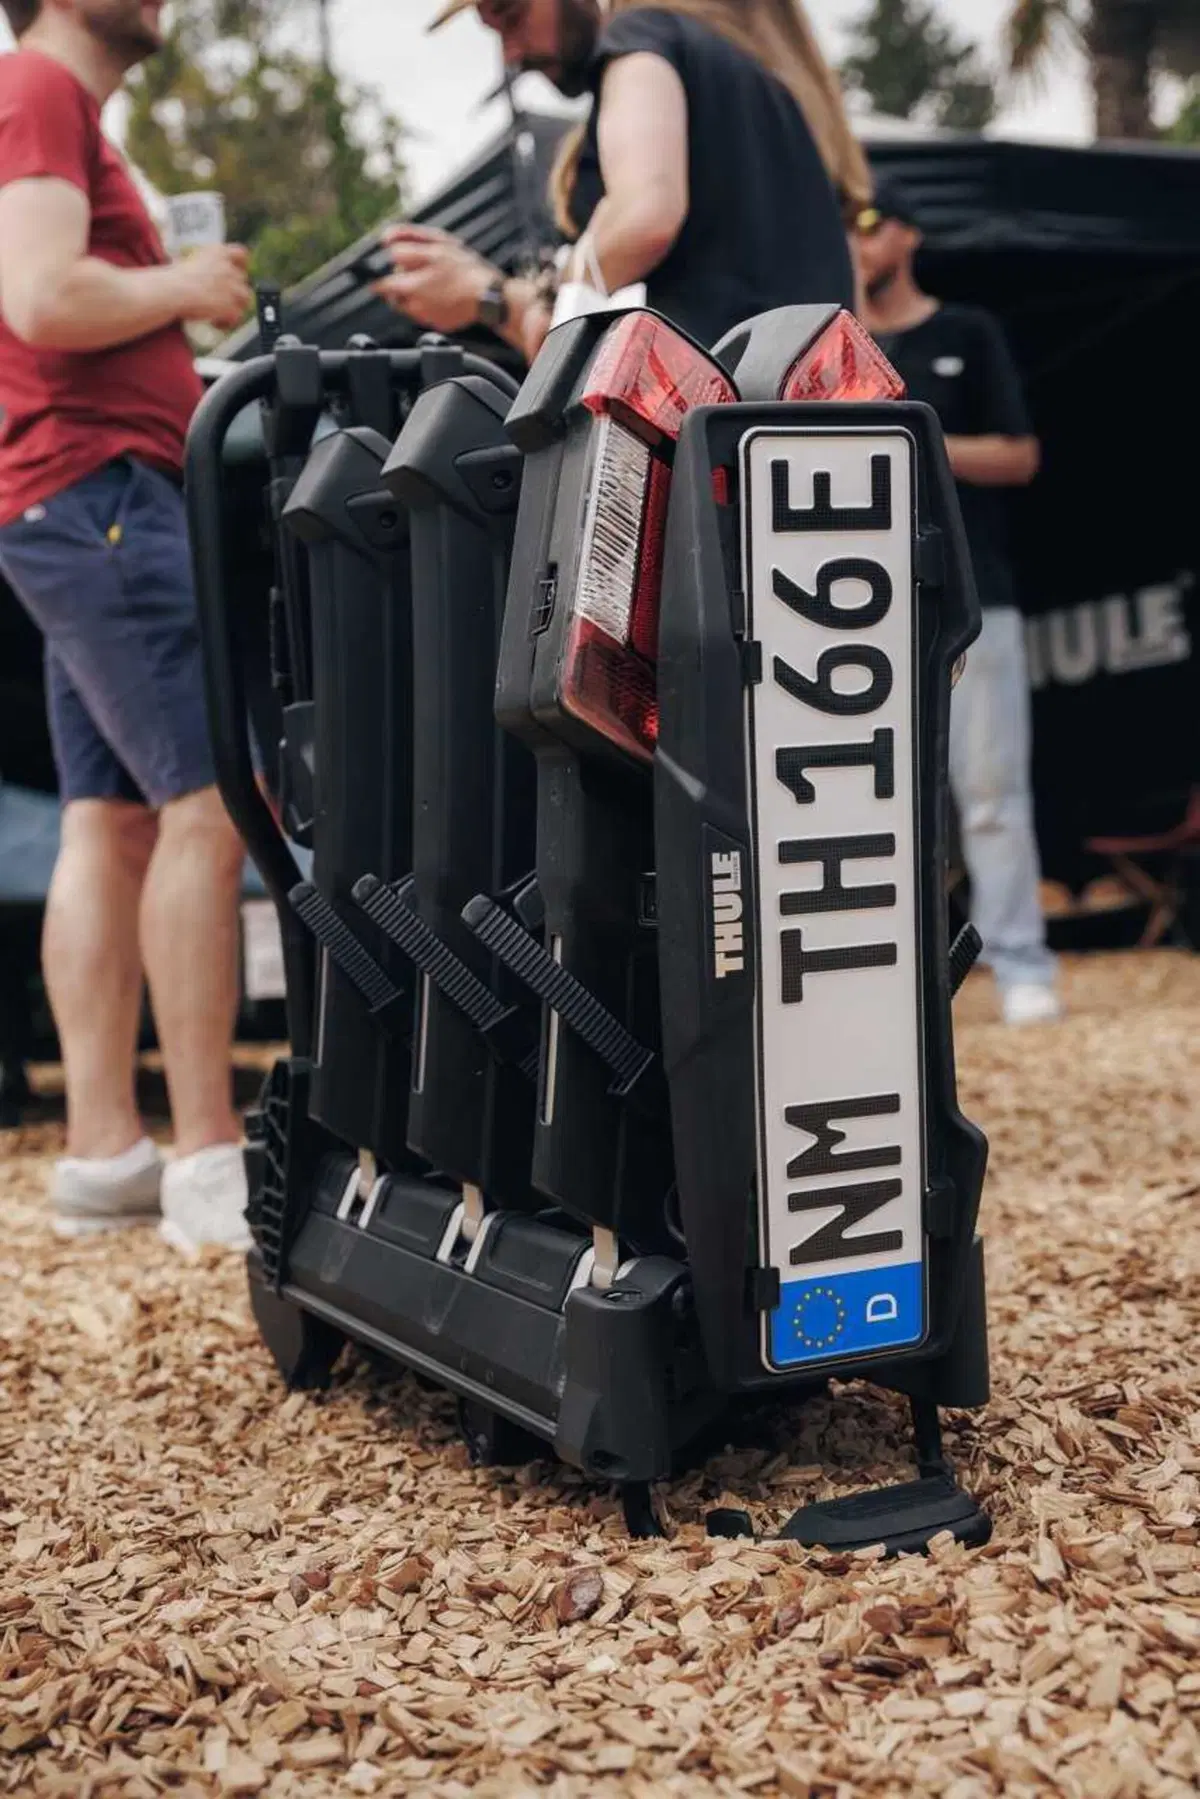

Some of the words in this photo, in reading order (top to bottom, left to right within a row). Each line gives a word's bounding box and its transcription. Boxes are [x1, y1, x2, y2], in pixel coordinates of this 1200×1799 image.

[711, 850, 744, 978] THULE
[784, 1093, 902, 1265] NM
[866, 1293, 898, 1323] D
